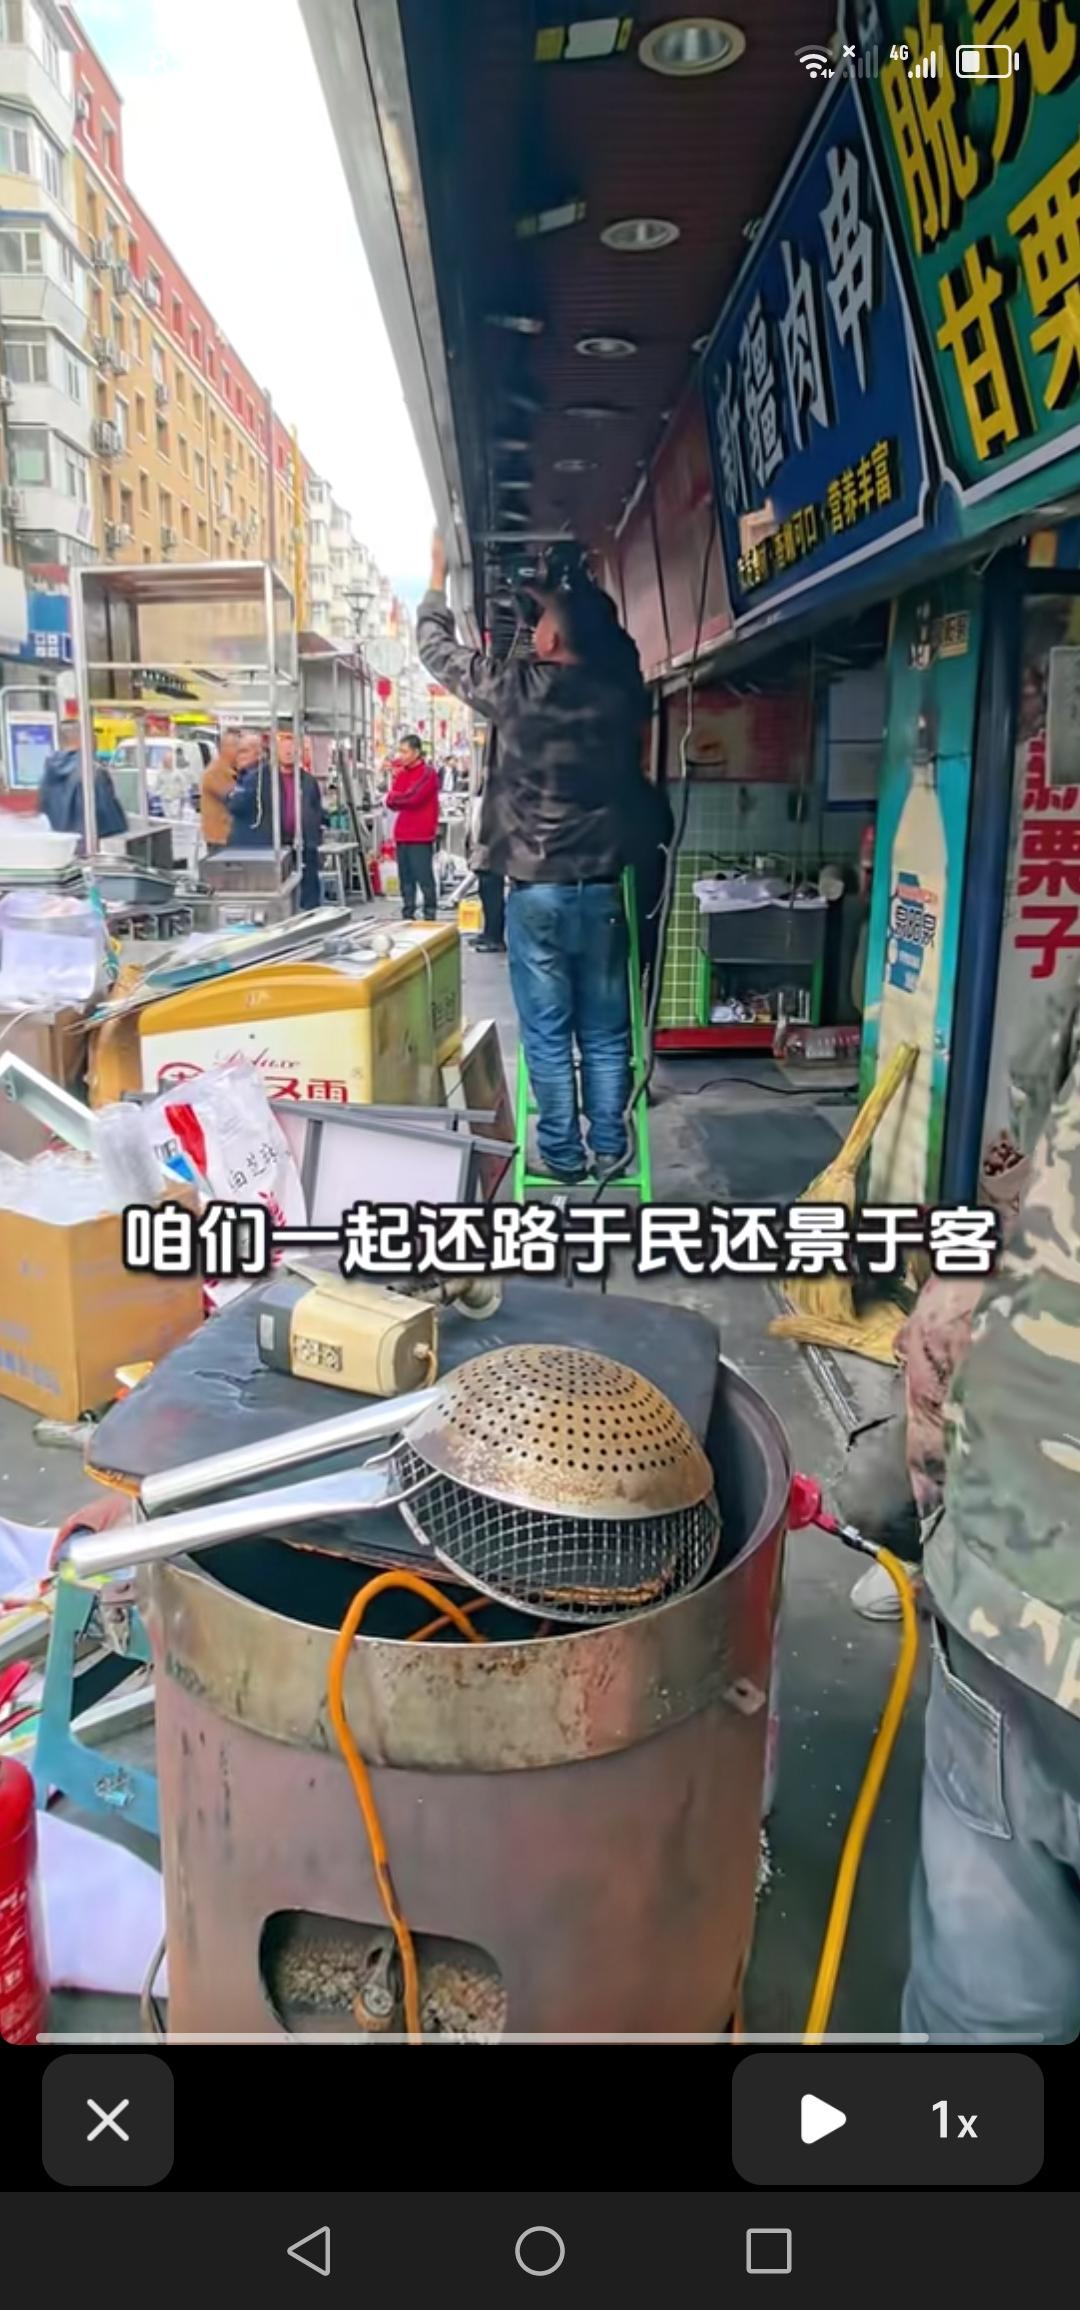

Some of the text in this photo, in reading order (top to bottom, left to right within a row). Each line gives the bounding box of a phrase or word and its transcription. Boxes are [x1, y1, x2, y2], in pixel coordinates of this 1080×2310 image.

[714, 147, 873, 516] 新疆肉串
[937, 126, 1080, 461] 甘栗
